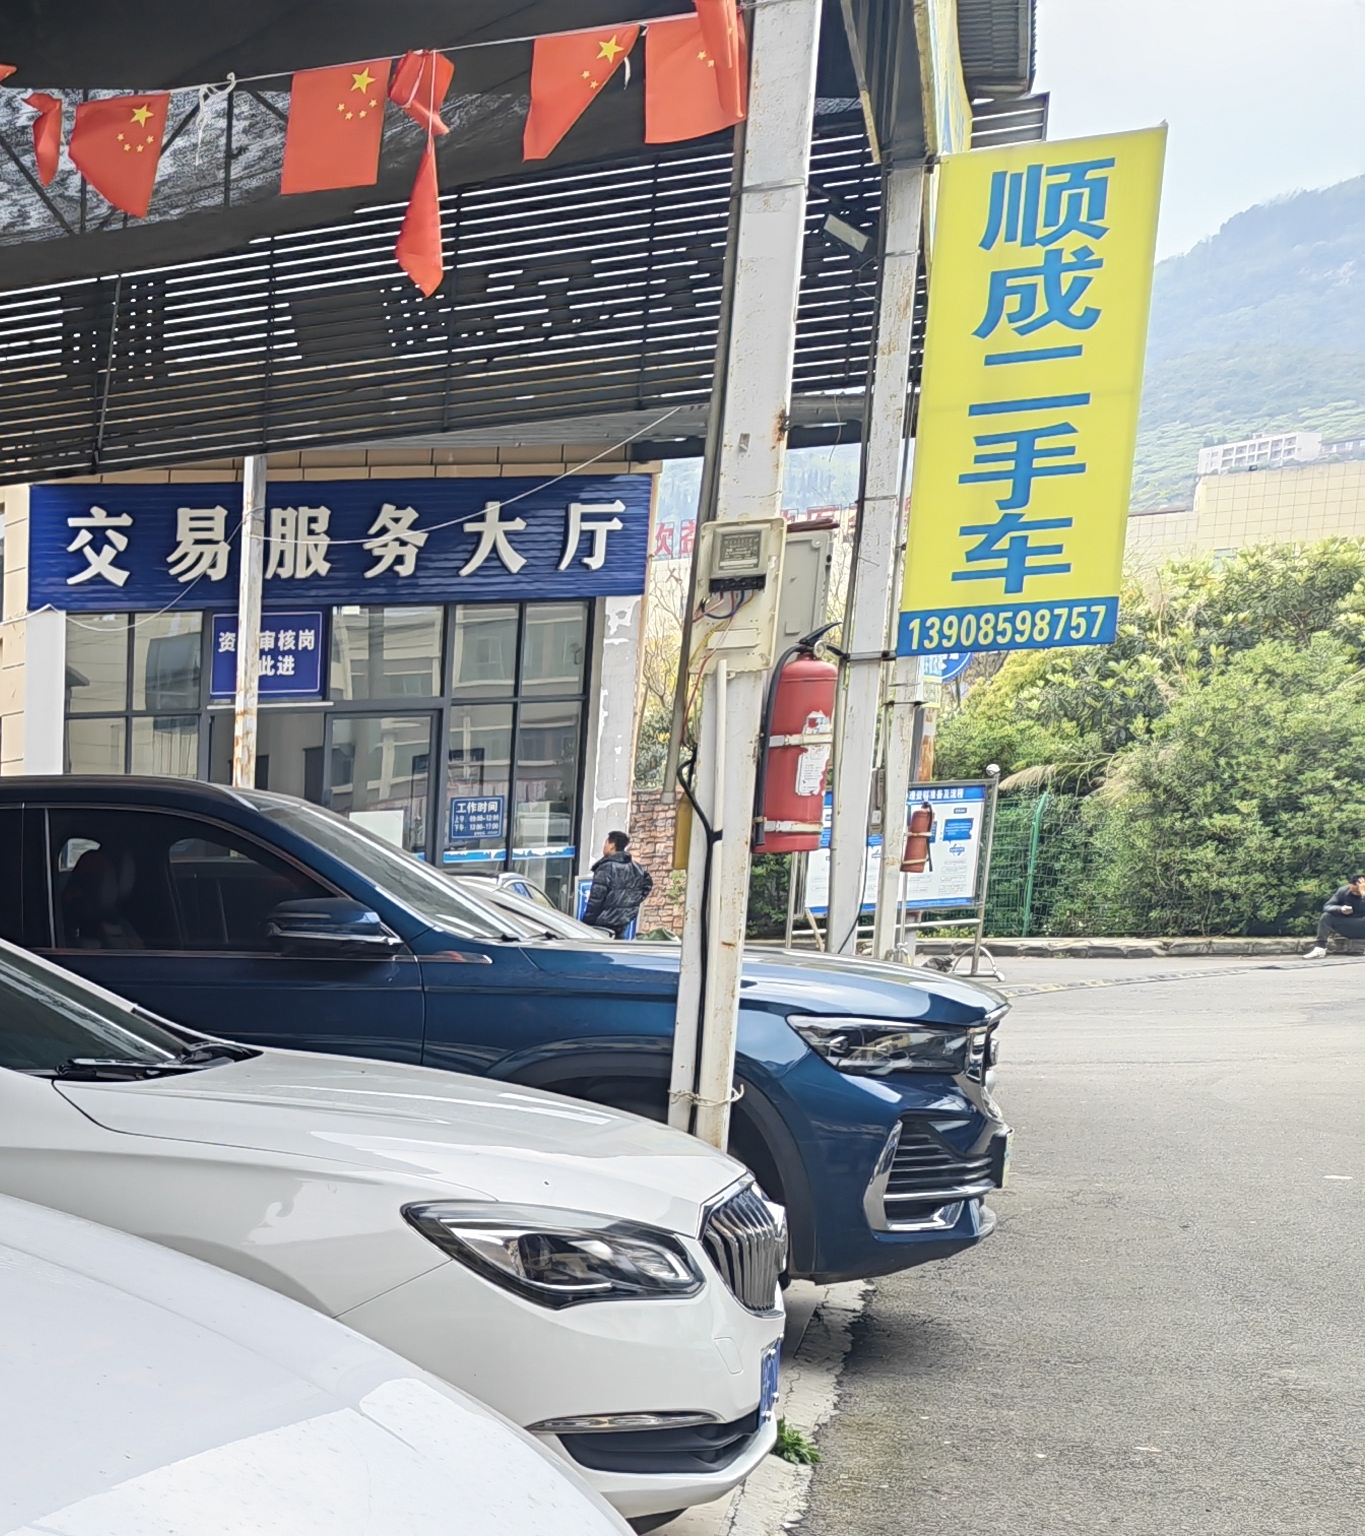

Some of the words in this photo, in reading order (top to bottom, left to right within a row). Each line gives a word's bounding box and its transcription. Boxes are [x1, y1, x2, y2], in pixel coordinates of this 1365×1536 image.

[951, 157, 1116, 595] 顺成二手车
[66, 500, 627, 587] 交易服务大厅
[218, 629, 316, 653] 资审核岗
[908, 606, 1108, 652] 13908598757
[258, 655, 295, 677] 此进
